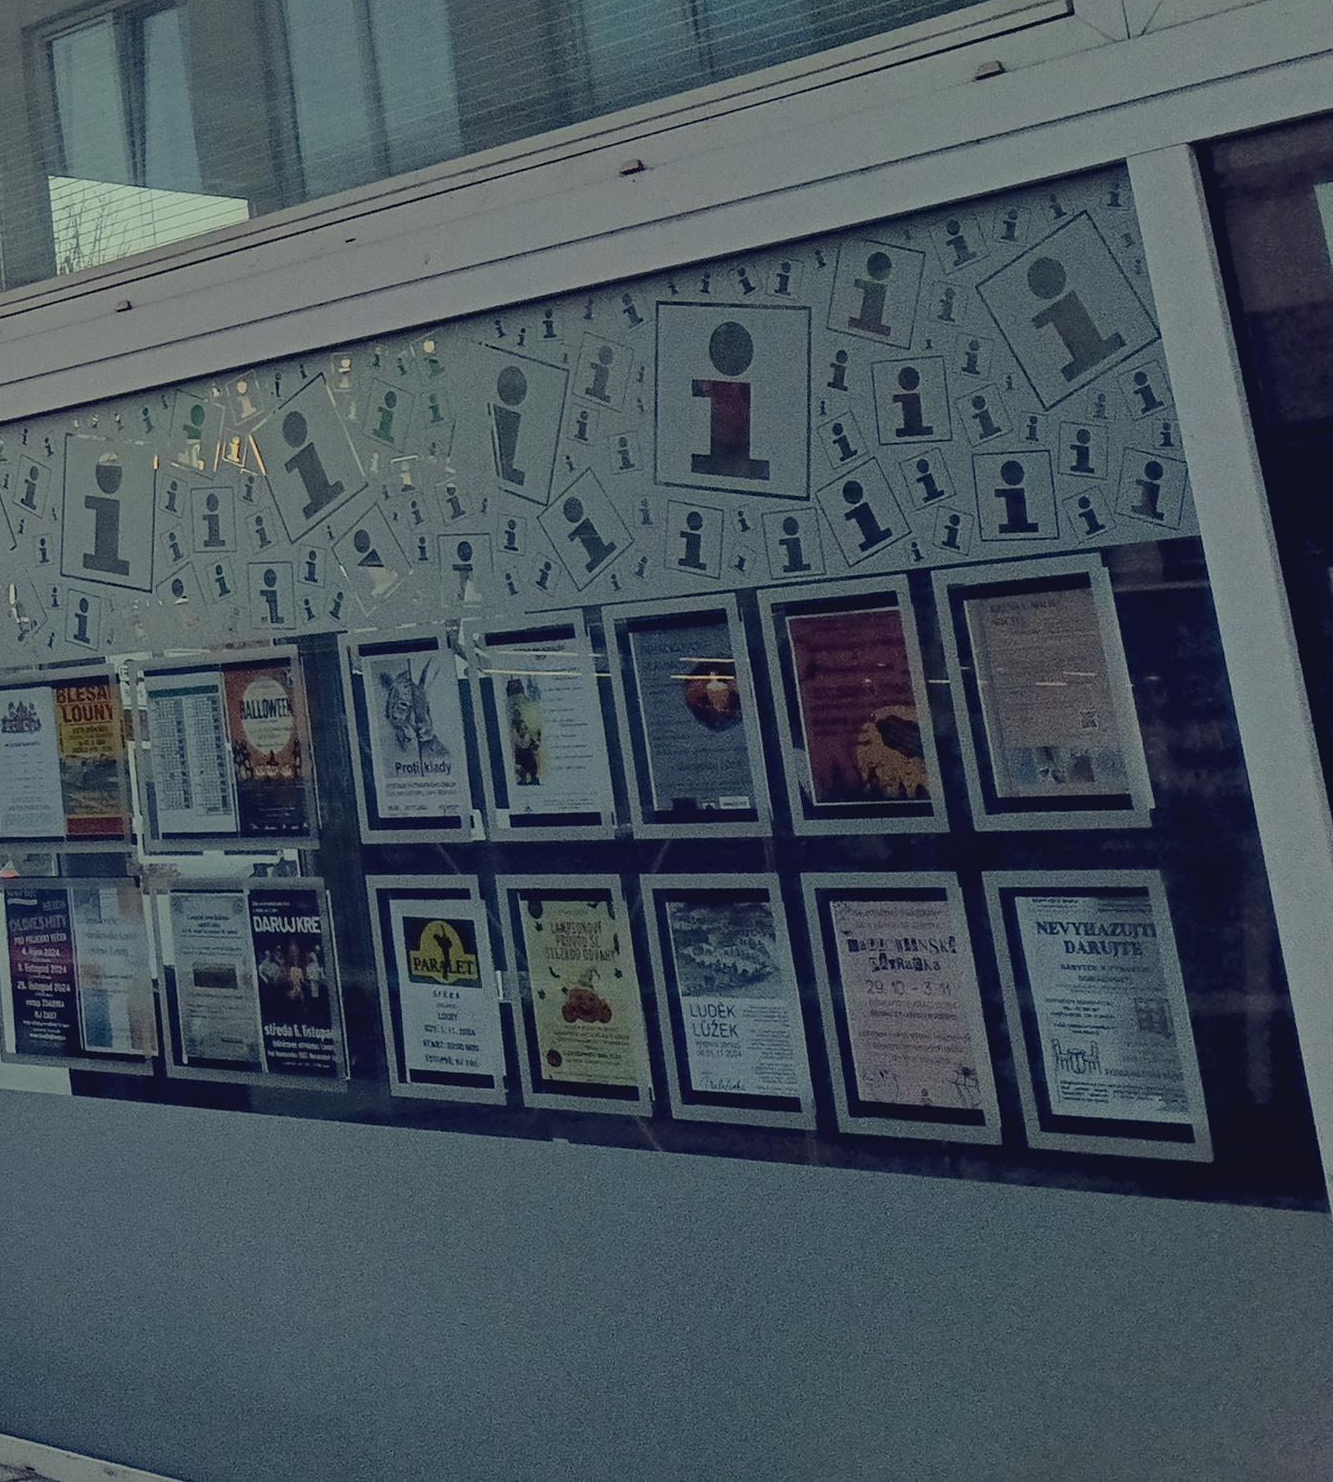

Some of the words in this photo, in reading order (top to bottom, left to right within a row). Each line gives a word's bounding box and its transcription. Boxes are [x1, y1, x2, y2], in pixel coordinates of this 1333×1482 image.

[61, 704, 113, 724] LOUNY
[253, 915, 295, 934] DARUJ
[296, 915, 322, 934] KRE
[1063, 940, 1143, 958] DARUJTE
[689, 1001, 737, 1019] LUDĚK
[302, 1023, 334, 1044] listopa
[692, 1019, 740, 1039] LŮŽEK
